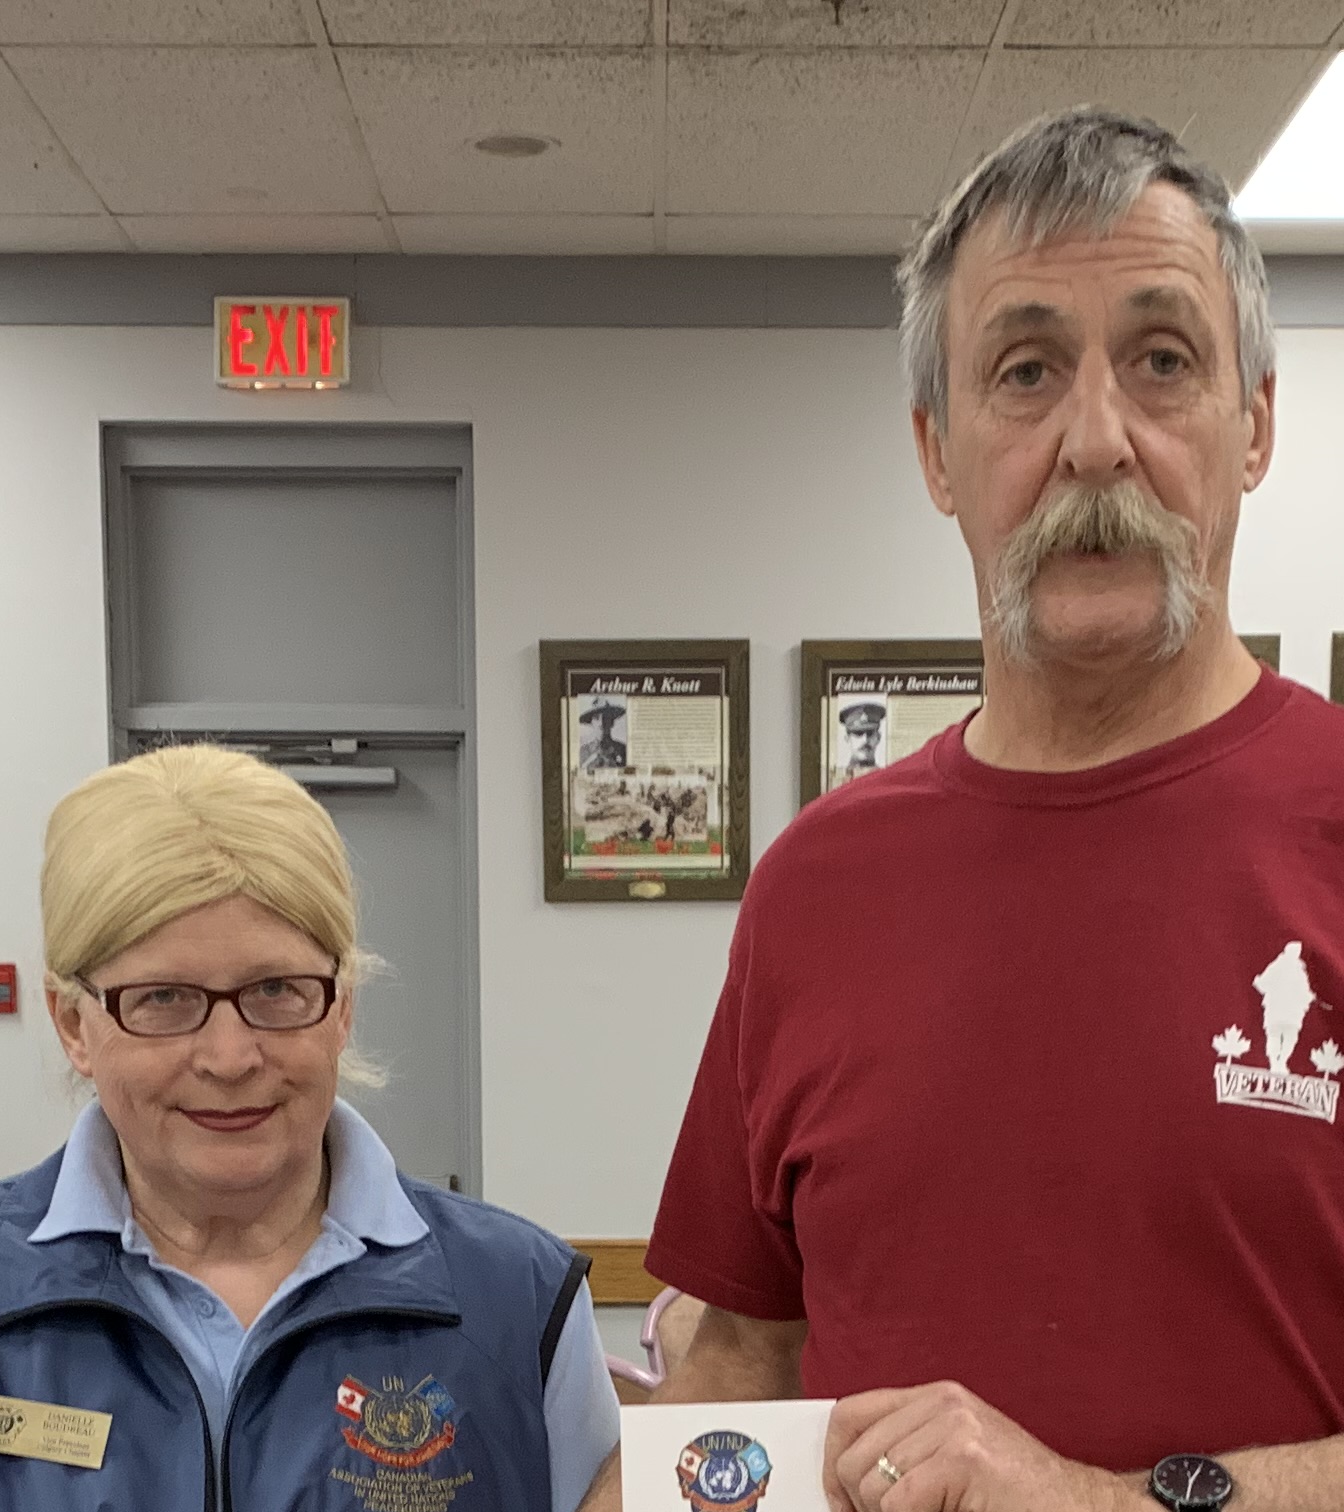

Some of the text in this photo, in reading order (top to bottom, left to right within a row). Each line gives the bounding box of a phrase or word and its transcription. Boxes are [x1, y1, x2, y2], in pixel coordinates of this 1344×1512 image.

[229, 304, 338, 376] EXIT
[590, 676, 701, 694] Arthur R. Knott
[836, 675, 875, 691] Edwin
[1218, 1070, 1334, 1117] VETERAN
[382, 1375, 405, 1392] UN
